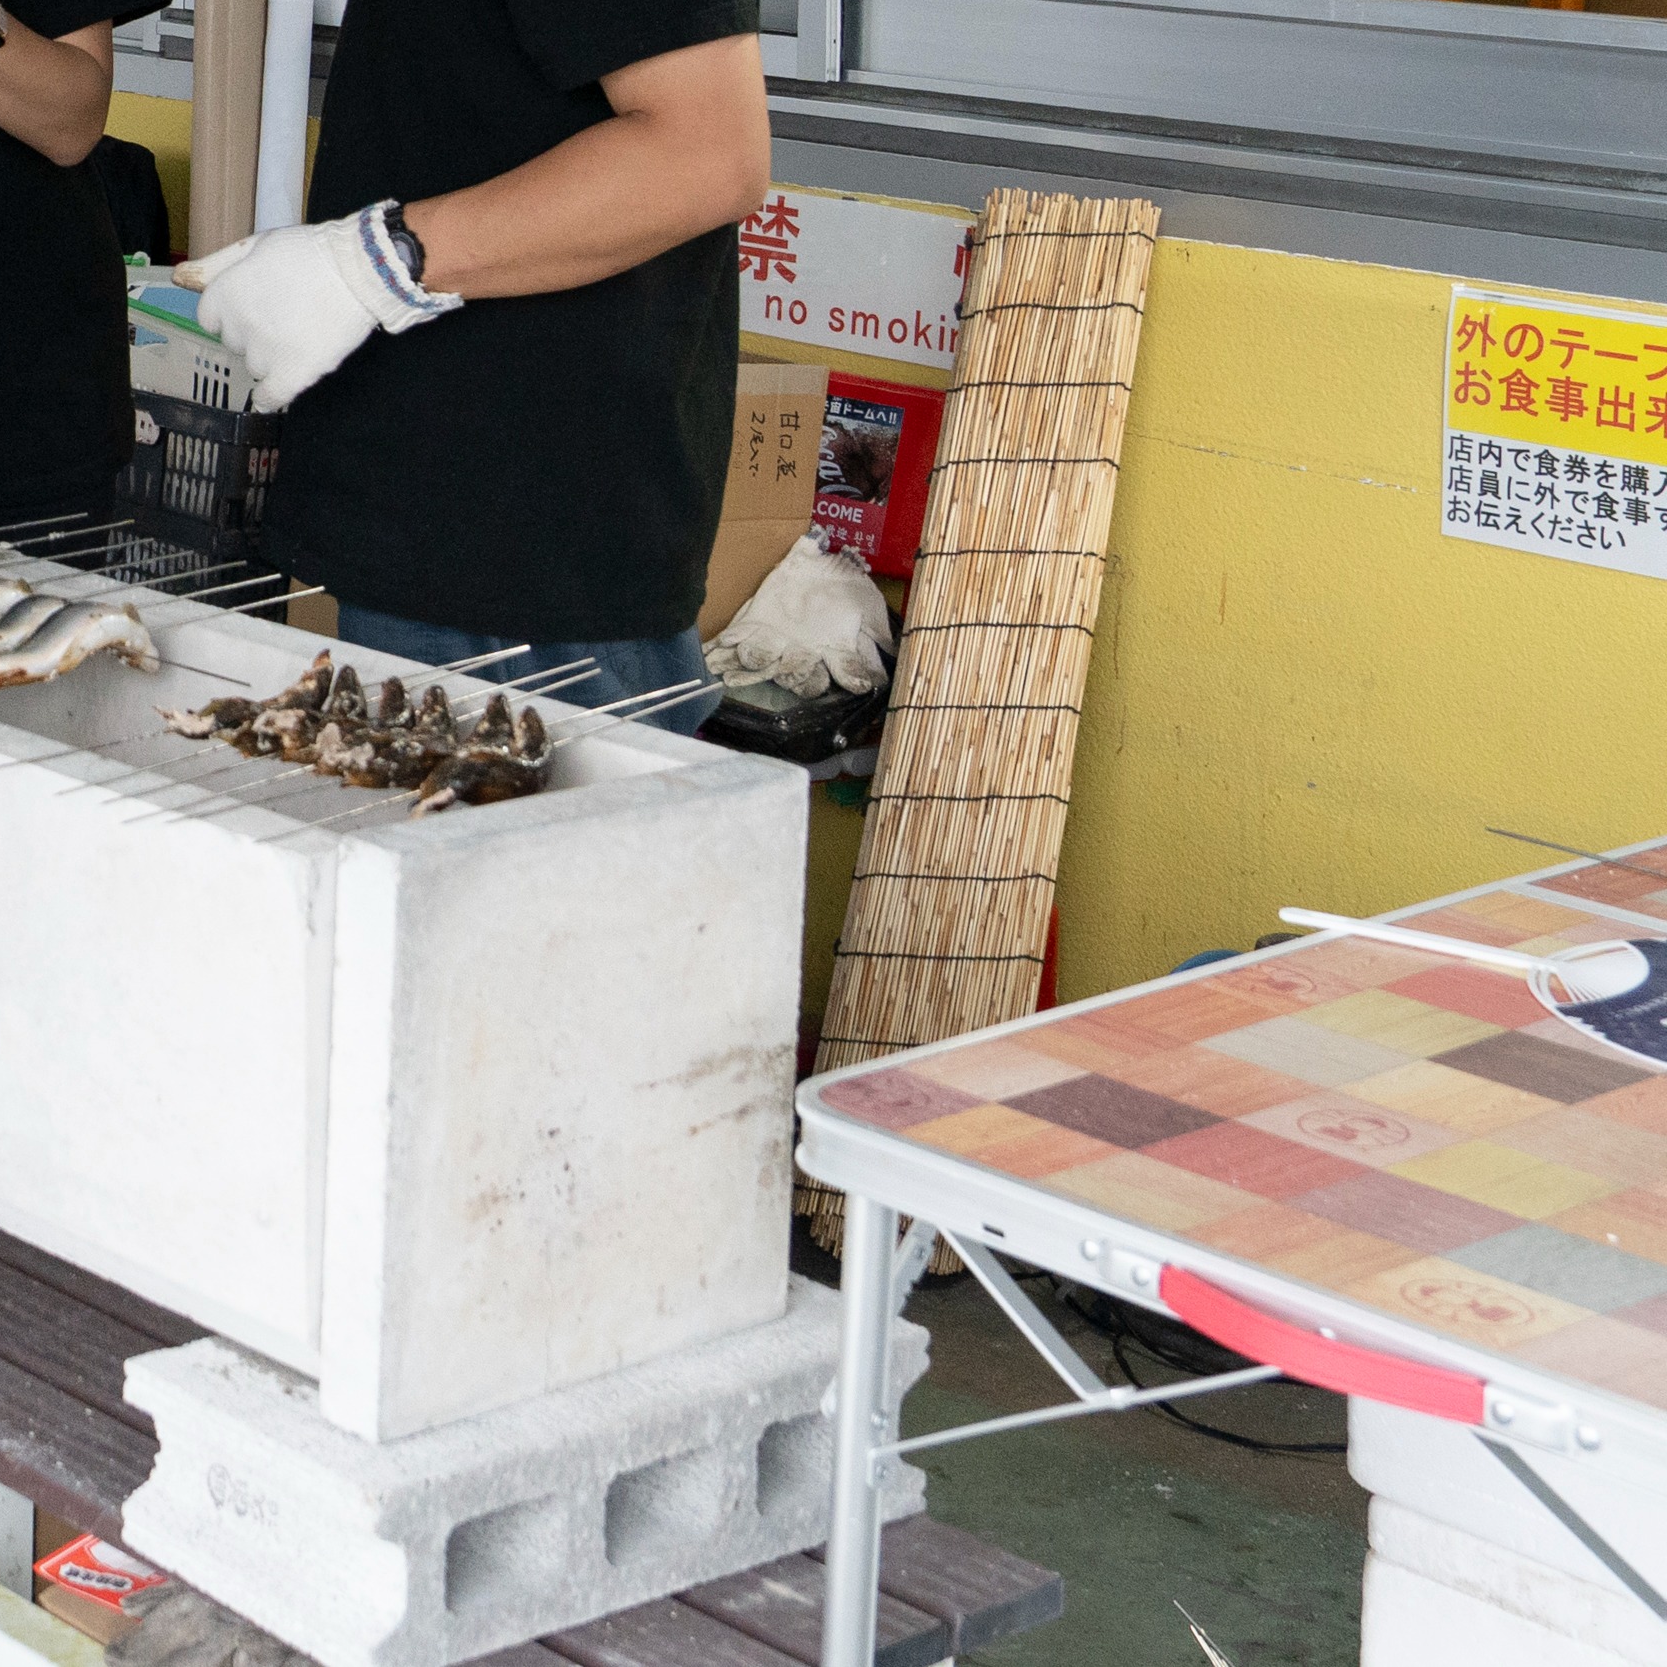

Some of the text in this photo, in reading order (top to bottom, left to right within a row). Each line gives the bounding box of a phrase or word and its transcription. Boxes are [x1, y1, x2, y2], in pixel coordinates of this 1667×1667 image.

[738, 194, 801, 284] 禁
[765, 294, 807, 325] no
[1447, 495, 1626, 550] お伝えください
